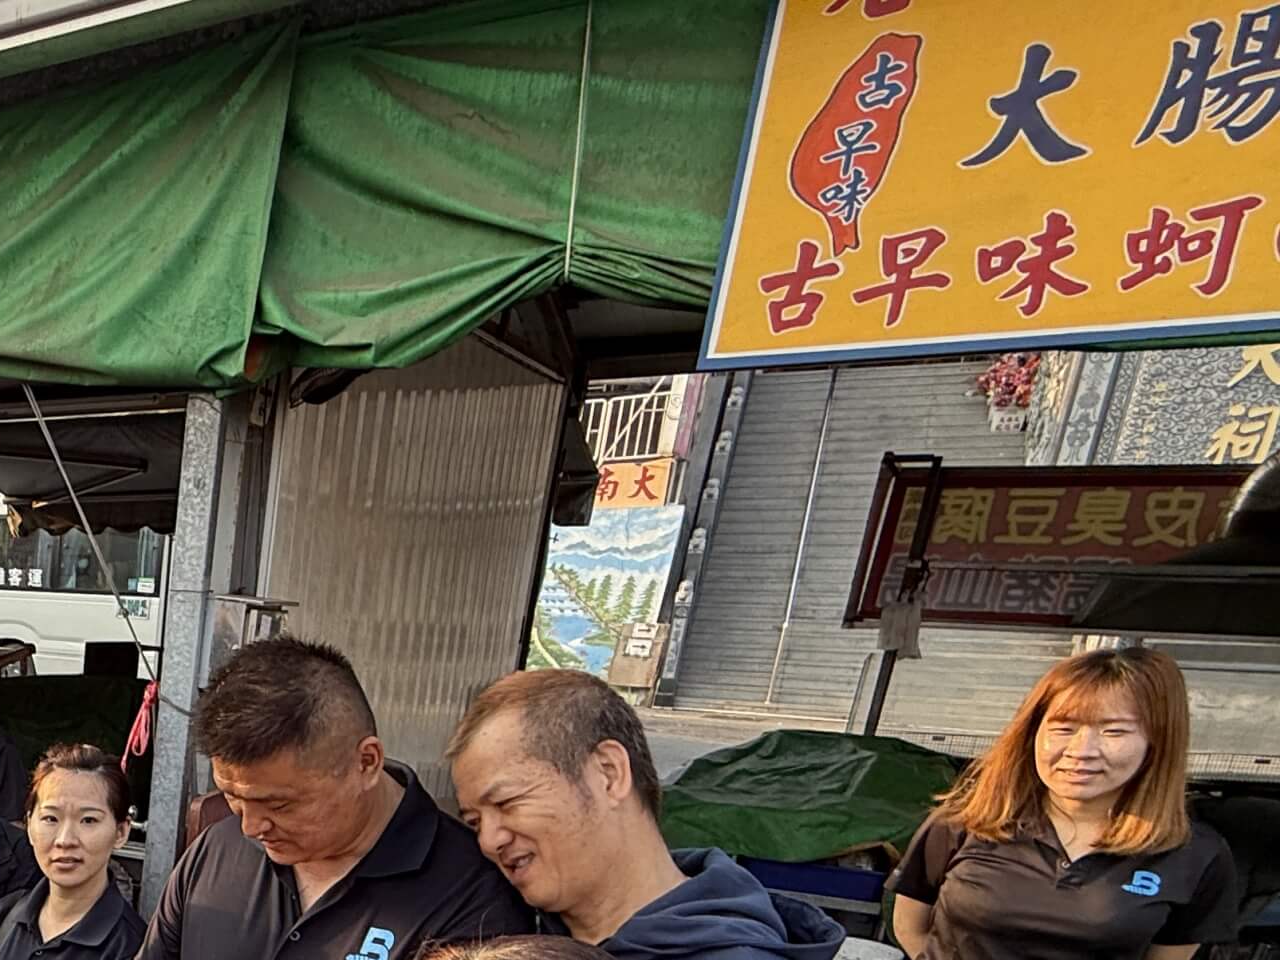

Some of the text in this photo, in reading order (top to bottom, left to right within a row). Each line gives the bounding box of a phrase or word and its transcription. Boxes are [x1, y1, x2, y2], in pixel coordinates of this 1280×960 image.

[818, 52, 908, 226] 古早味
[758, 195, 1280, 335] 古早味蚵
